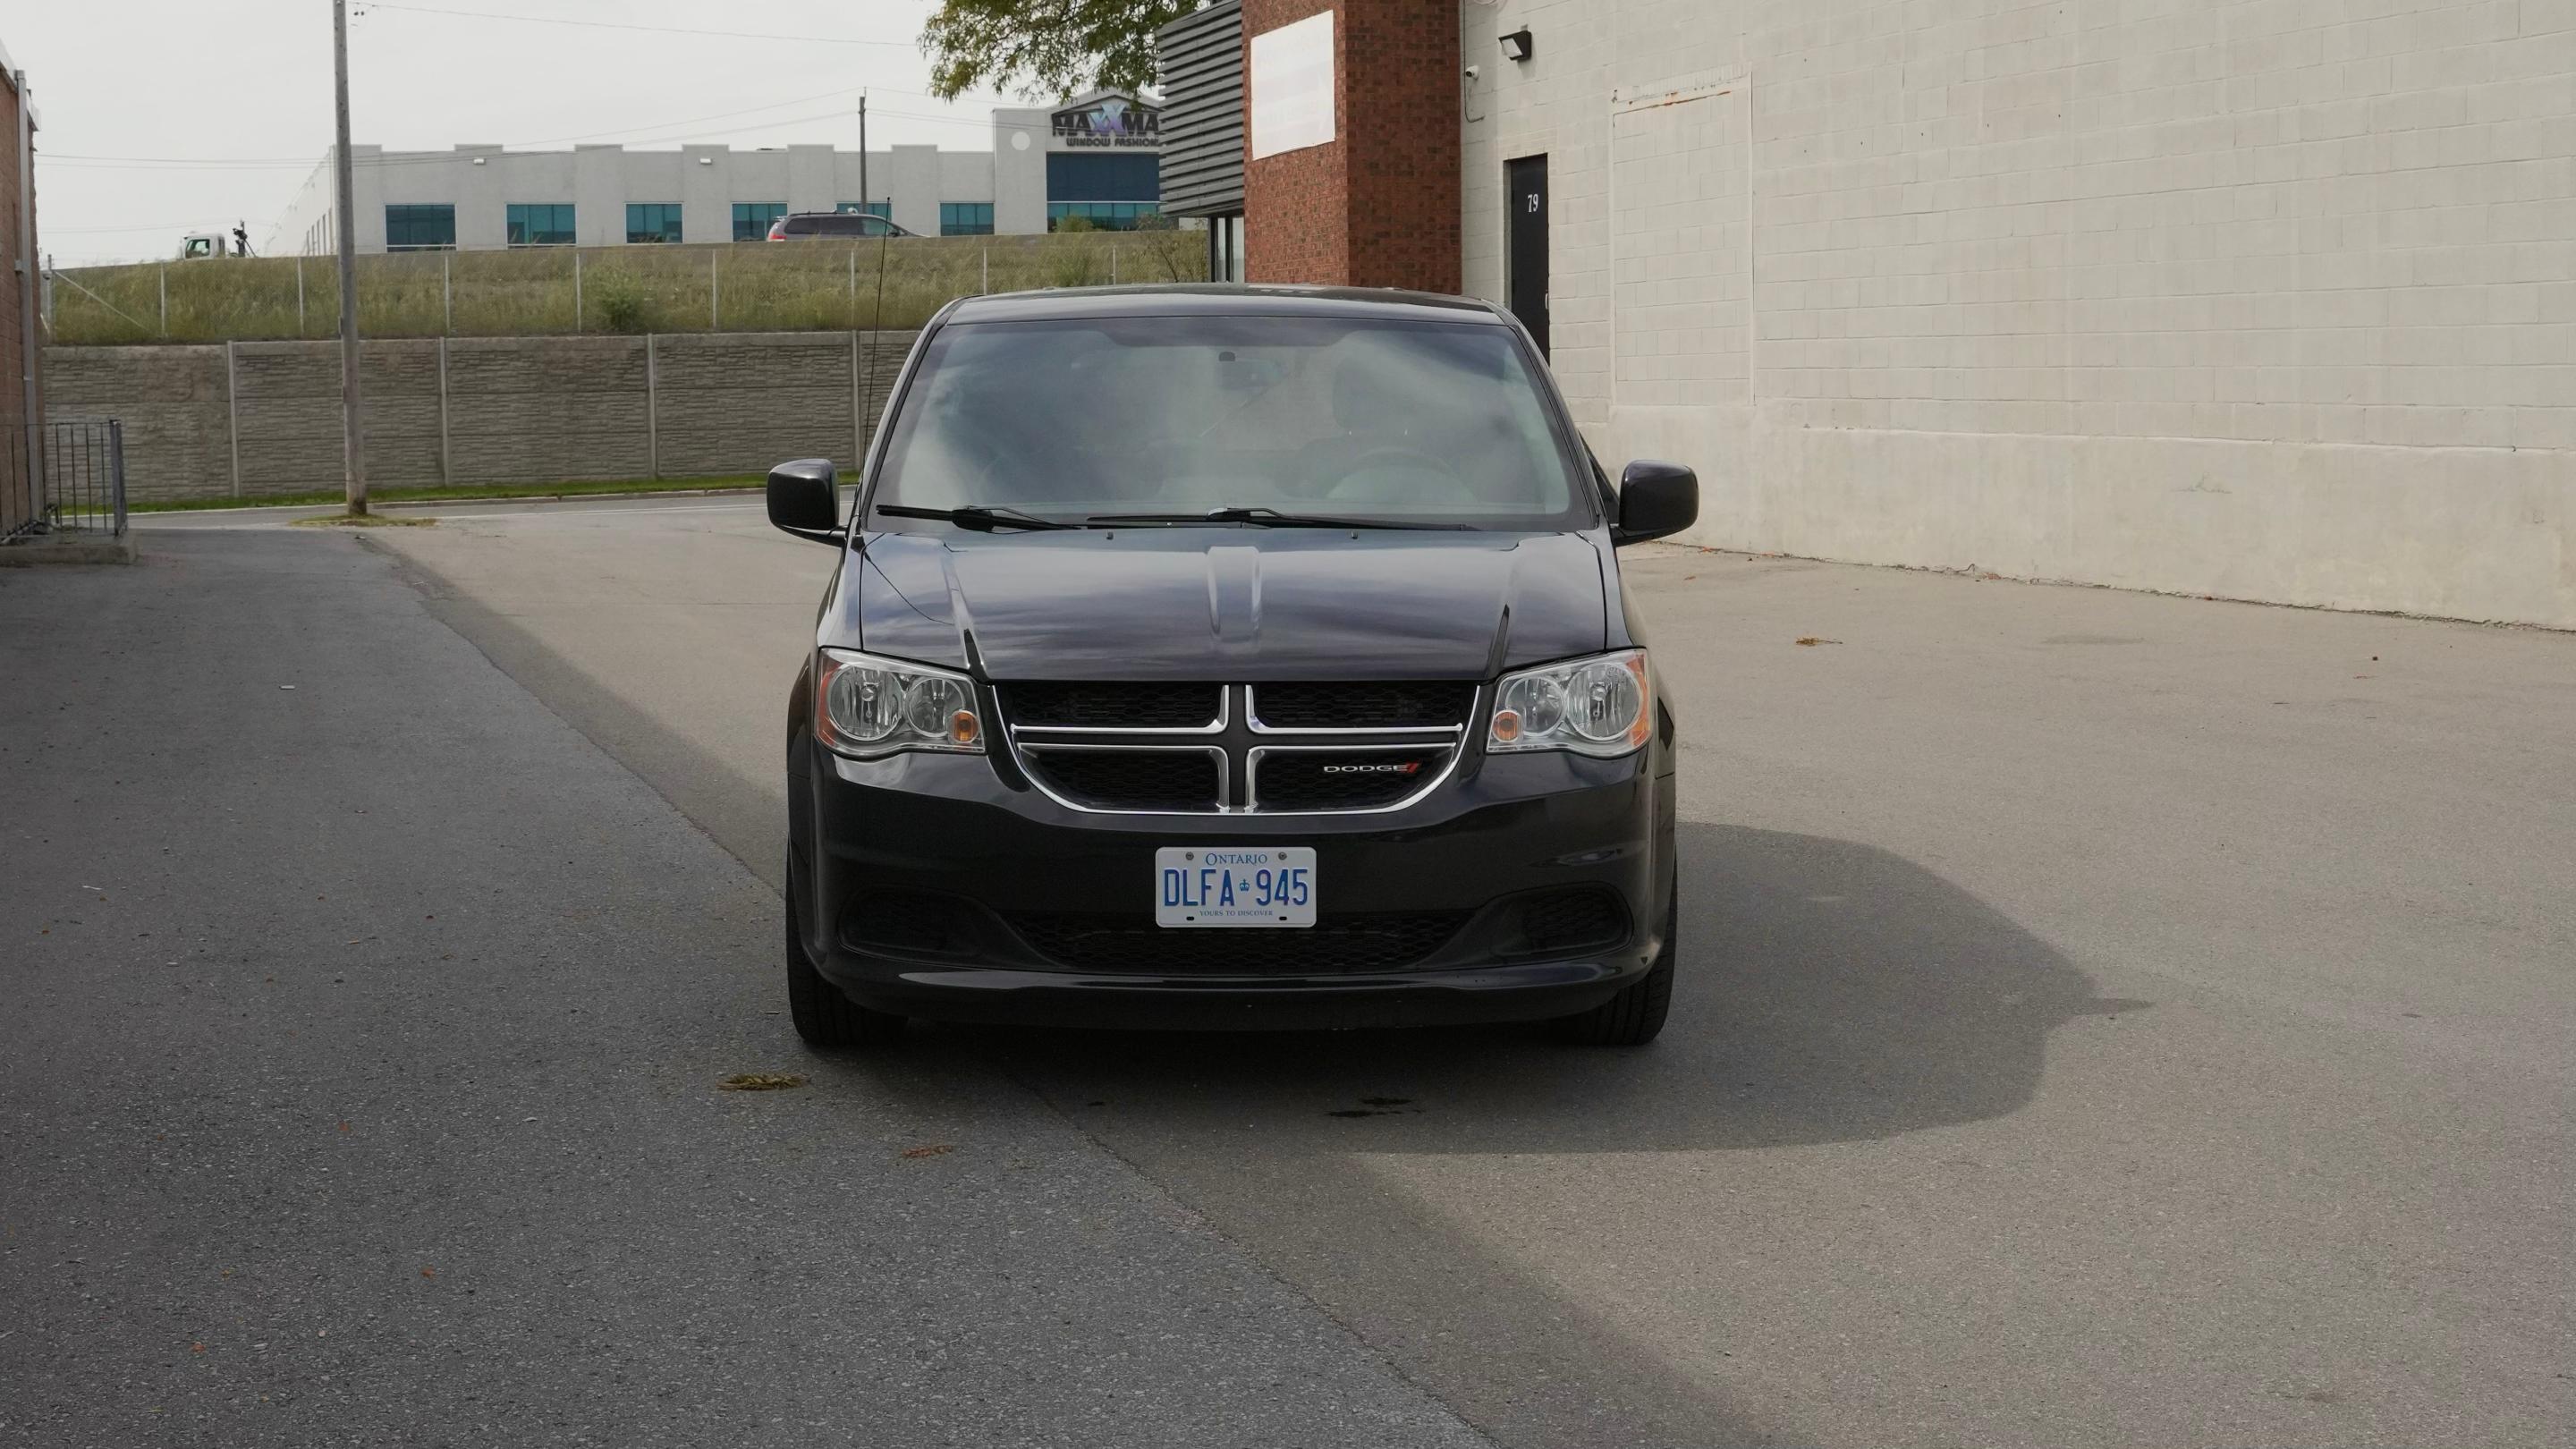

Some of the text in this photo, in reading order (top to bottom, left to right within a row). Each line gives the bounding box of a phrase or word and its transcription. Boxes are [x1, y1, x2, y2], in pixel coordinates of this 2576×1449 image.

[1066, 138, 1111, 147] WINDOW
[1527, 193, 1538, 212] 79
[1205, 852, 1267, 866] ONTARIO
[1164, 869, 1308, 906] DLFA 945
